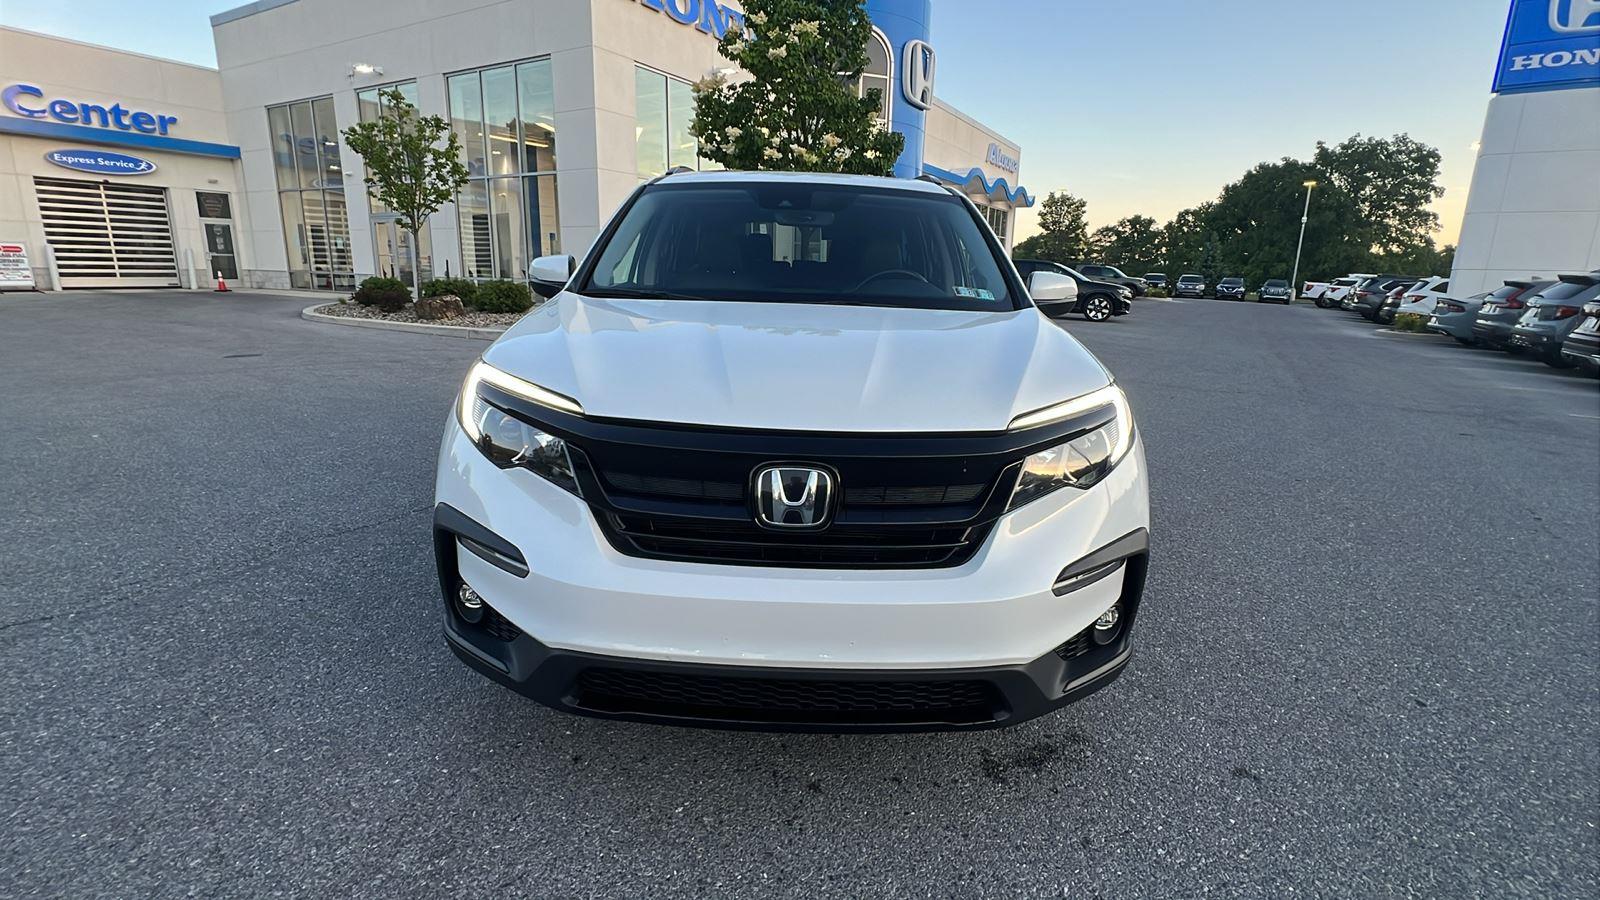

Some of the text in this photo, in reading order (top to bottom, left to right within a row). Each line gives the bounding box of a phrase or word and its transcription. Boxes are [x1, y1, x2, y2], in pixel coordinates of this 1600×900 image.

[1509, 48, 1600, 71] HON
[1, 84, 178, 135] Center
[53, 153, 135, 169] Express Service
